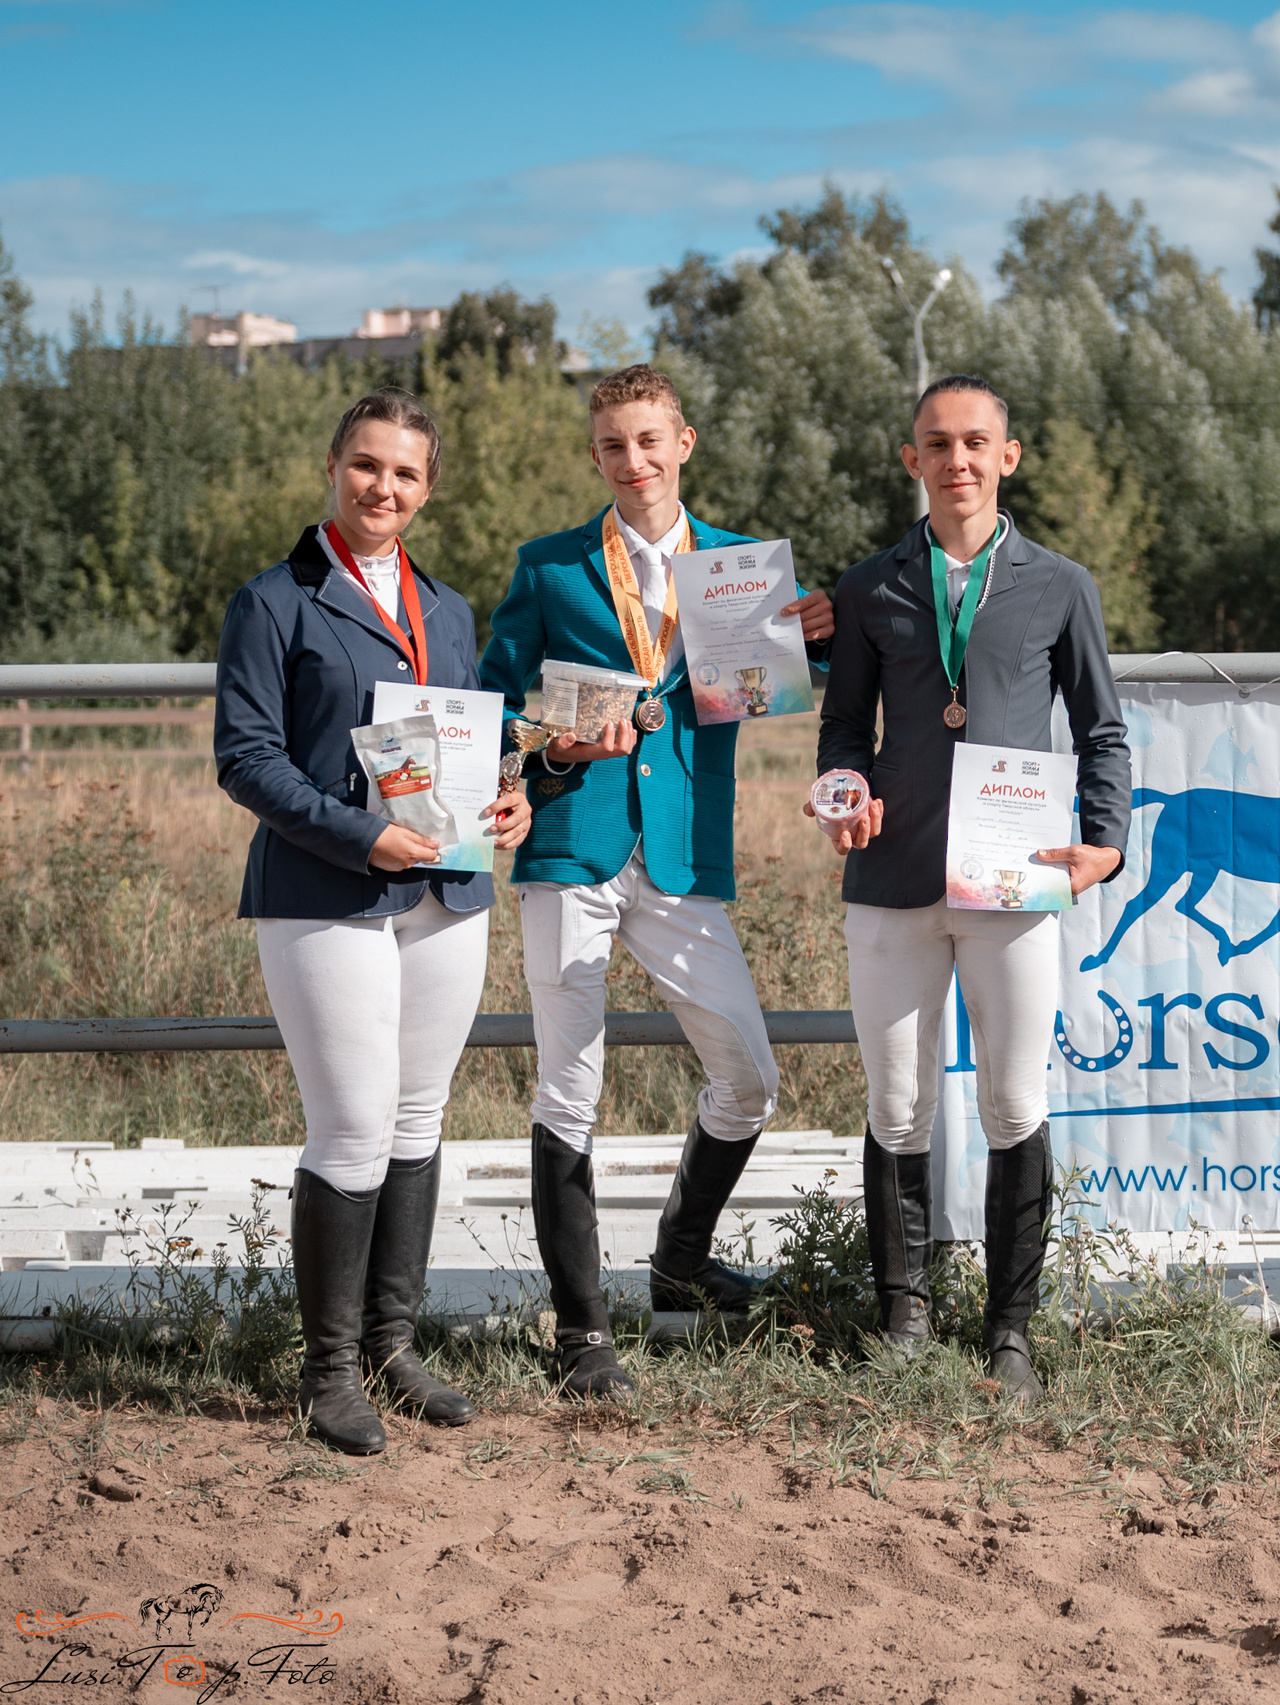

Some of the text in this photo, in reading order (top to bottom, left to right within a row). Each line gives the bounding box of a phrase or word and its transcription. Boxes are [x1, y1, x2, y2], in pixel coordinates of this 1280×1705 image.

[704, 580, 767, 600] ДИПЛОМ
[636, 615, 649, 646] ОБЛАСТЬ
[438, 726, 471, 739] ЛОМ
[980, 783, 1046, 800] ДИПЛОМ
